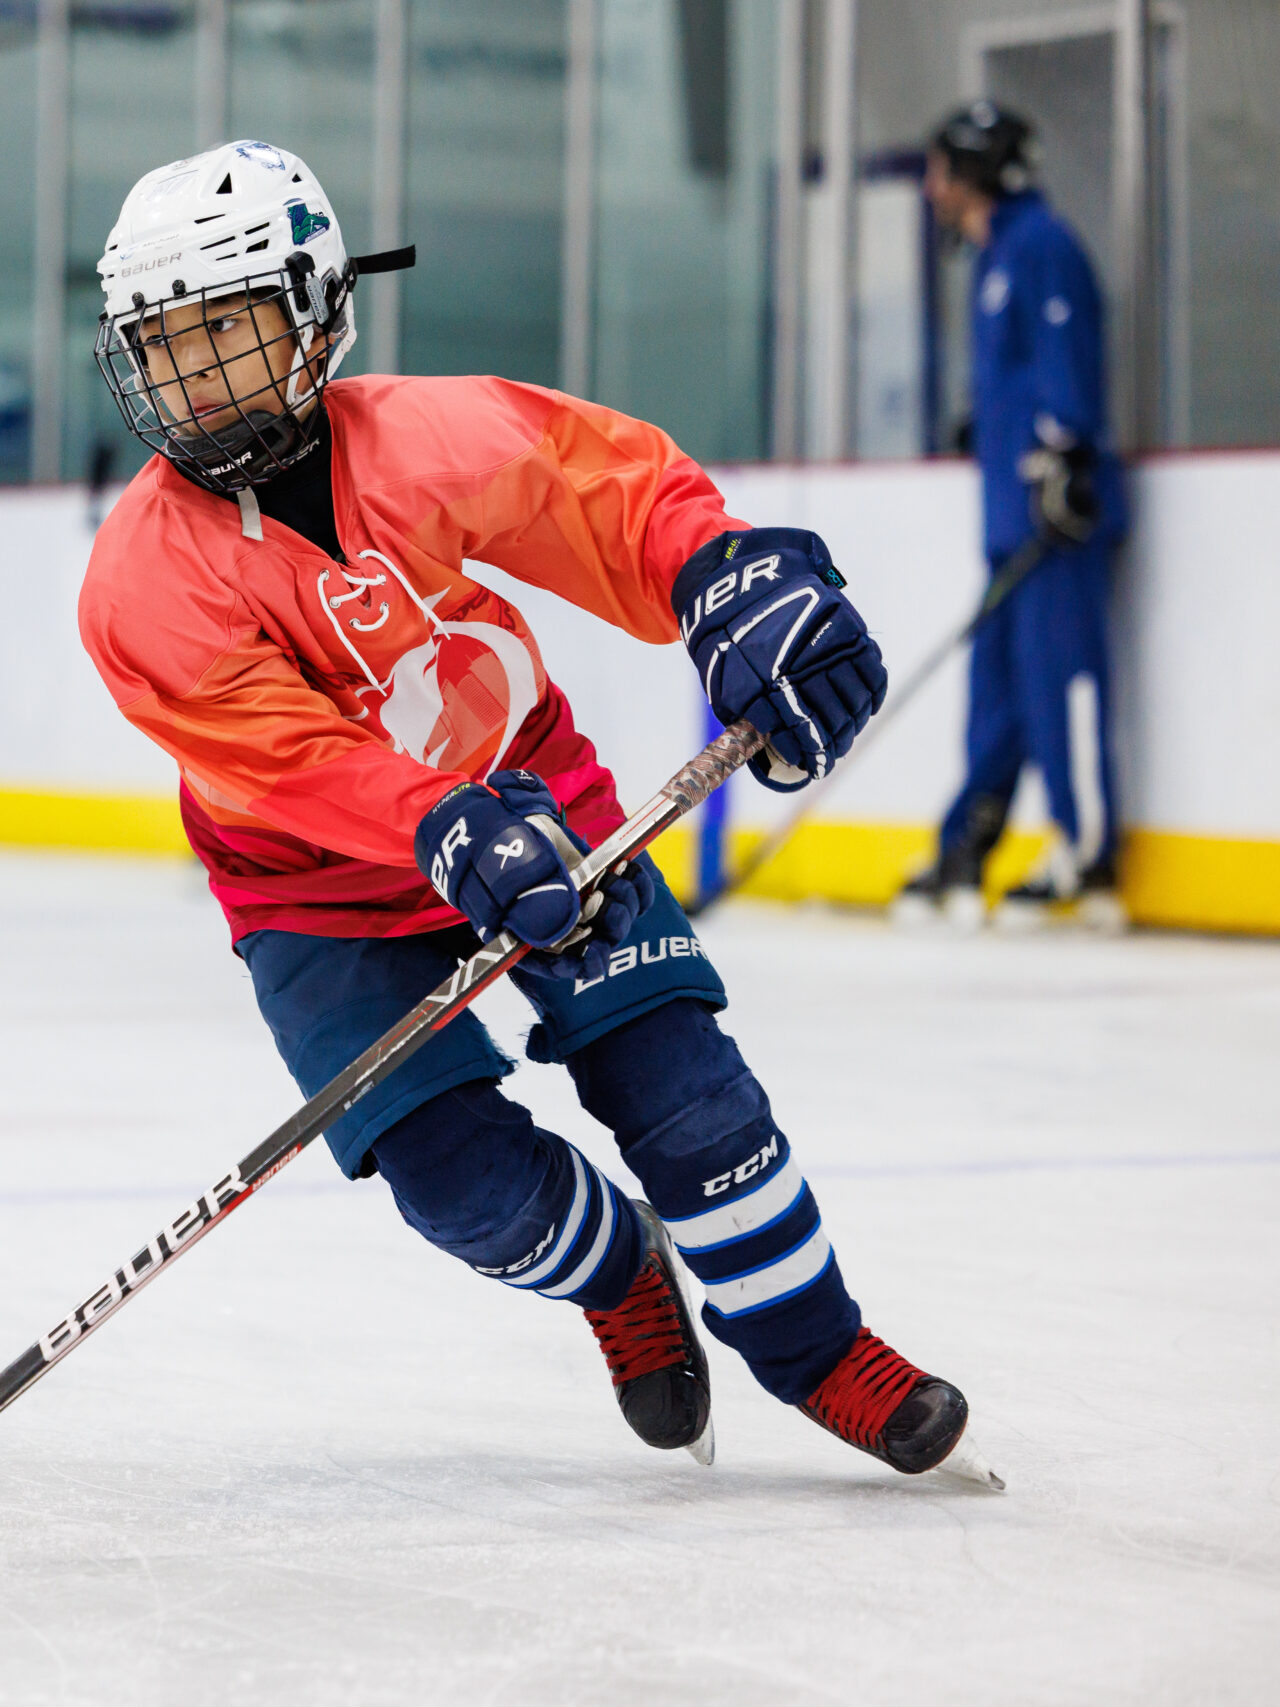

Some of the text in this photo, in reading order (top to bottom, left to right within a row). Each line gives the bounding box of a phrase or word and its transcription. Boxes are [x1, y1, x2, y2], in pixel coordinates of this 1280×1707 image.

[121, 252, 182, 278] BAUER
[680, 554, 783, 648] UER
[431, 816, 473, 908] ER
[701, 1134, 779, 1197] CCM
[38, 1164, 249, 1363] BAUER
[474, 1222, 556, 1275] CCM
